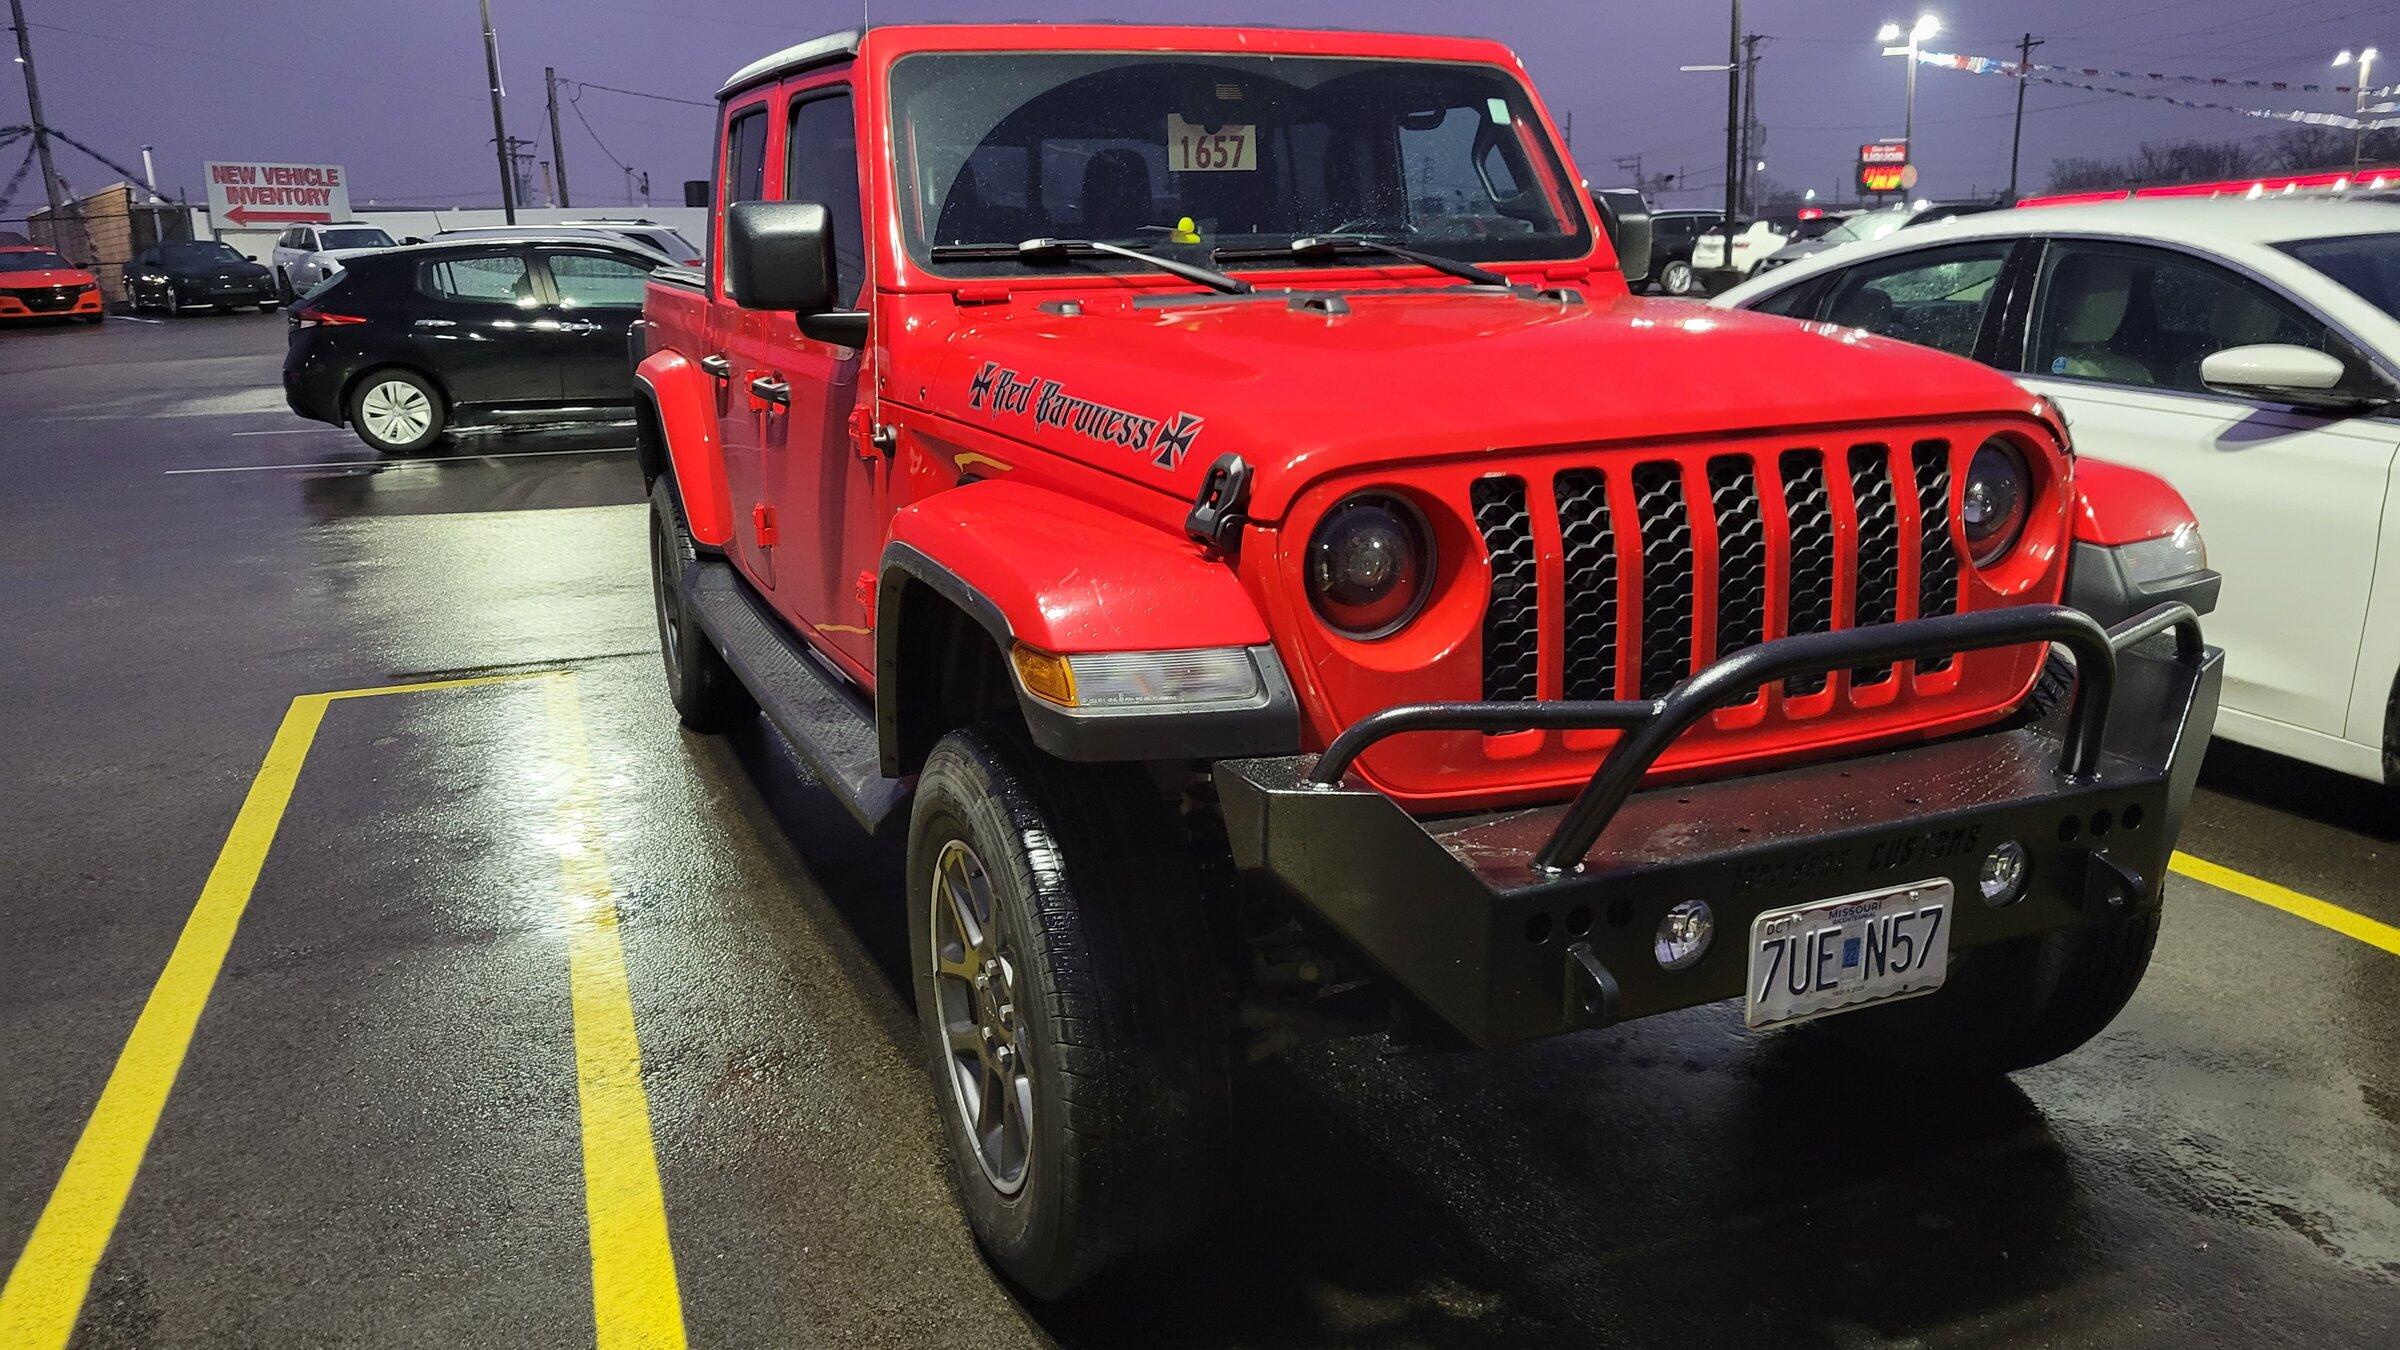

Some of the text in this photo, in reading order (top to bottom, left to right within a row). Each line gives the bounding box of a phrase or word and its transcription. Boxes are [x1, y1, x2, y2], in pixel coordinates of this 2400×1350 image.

[1181, 135, 1245, 168] 1657
[212, 165, 340, 187] NEW VEHICLE
[225, 186, 331, 206] INVENTORY
[992, 368, 1160, 453] Red Baroness
[1828, 901, 1882, 920] MISSOURI
[1766, 918, 1791, 936] OCT
[1757, 904, 1944, 1003] 7UE N57
